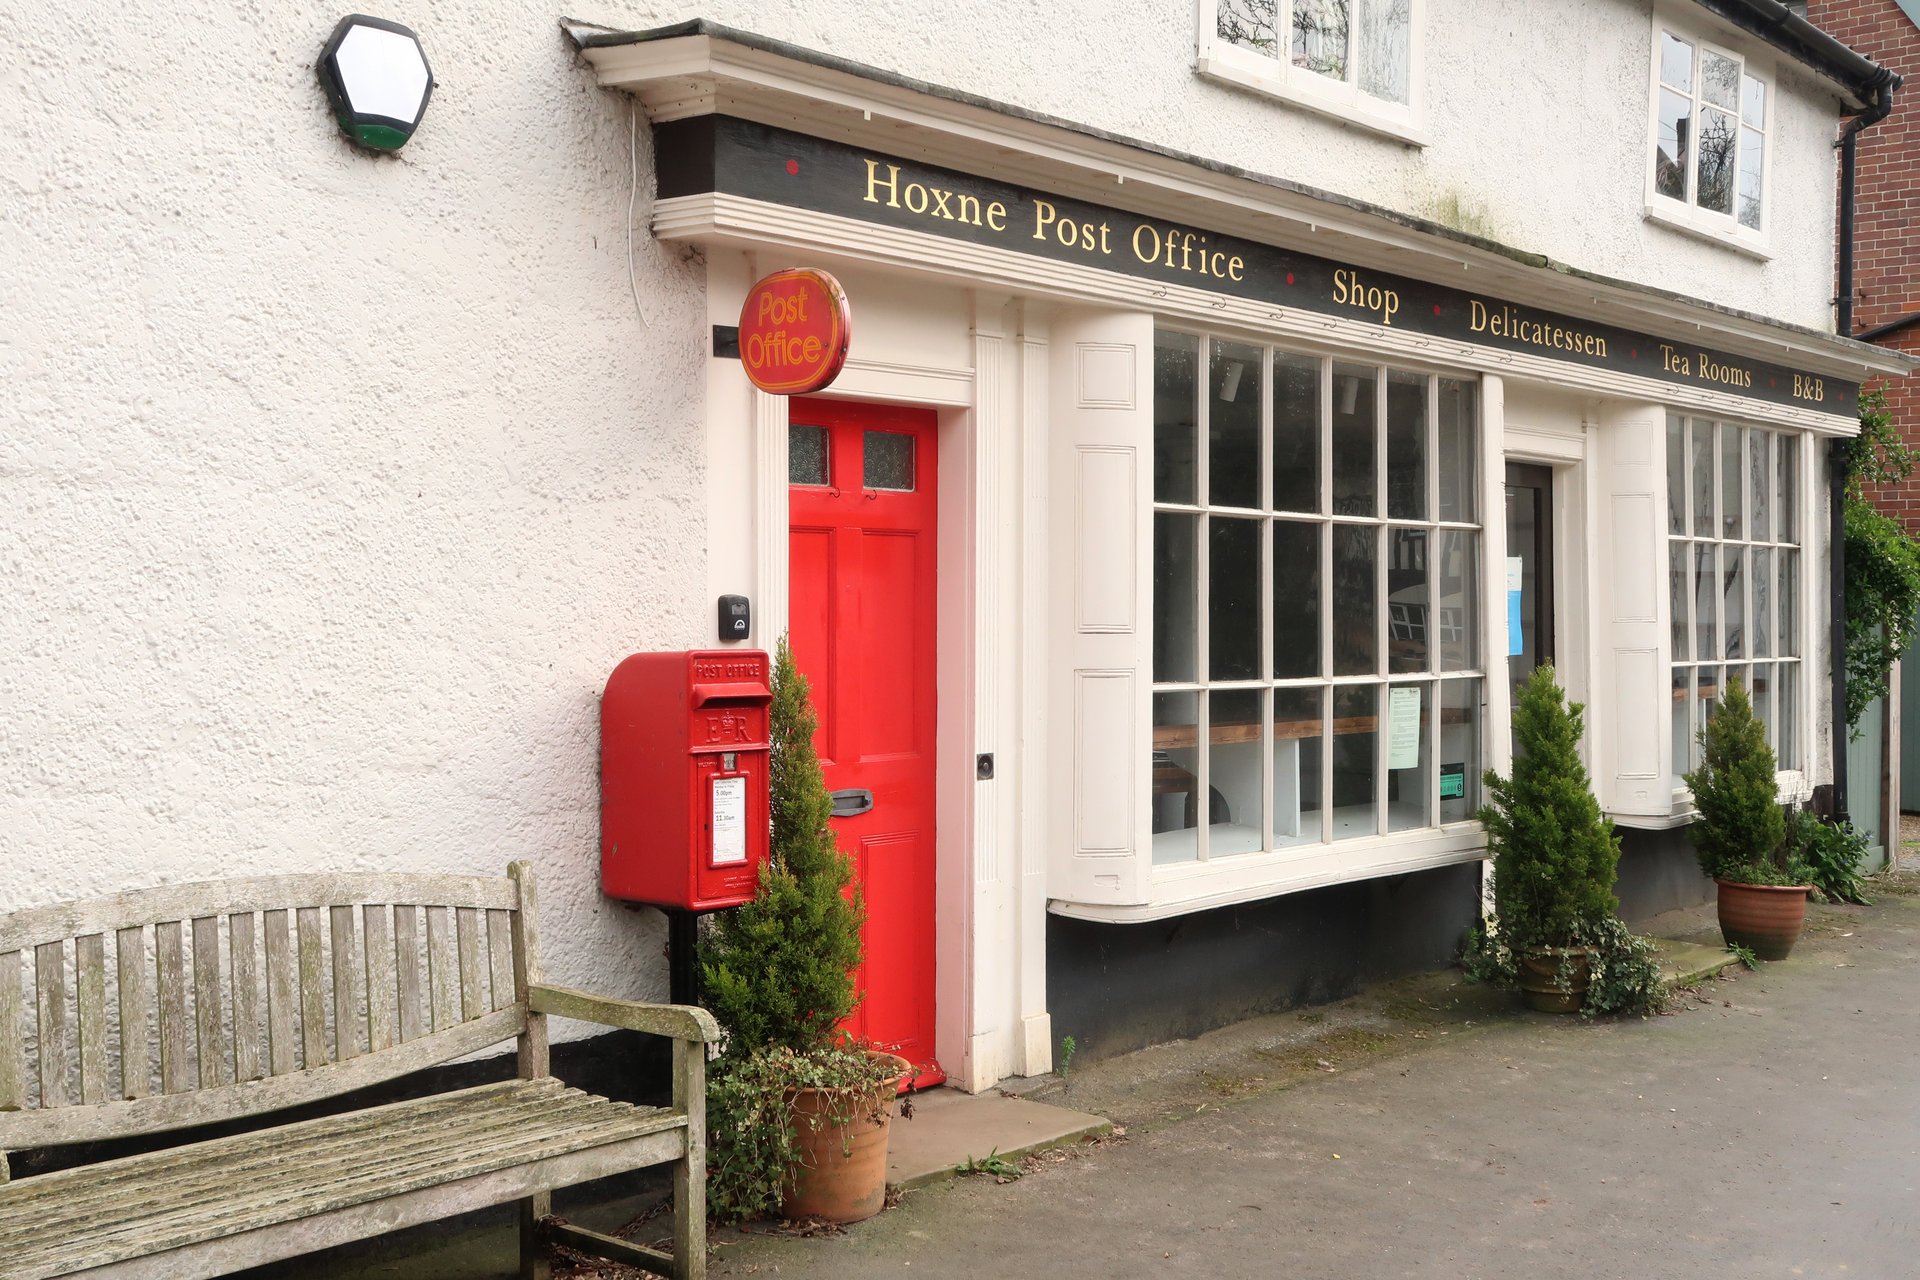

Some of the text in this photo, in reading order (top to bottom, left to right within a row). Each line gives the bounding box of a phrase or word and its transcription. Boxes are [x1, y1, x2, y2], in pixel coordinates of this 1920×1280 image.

[863, 158, 1825, 402] Hoxne Post Office Shop Delicatessen Tea Rooms B&B
[758, 286, 809, 328] Post
[747, 330, 821, 369] Office
[696, 663, 760, 678] POST OFFICE
